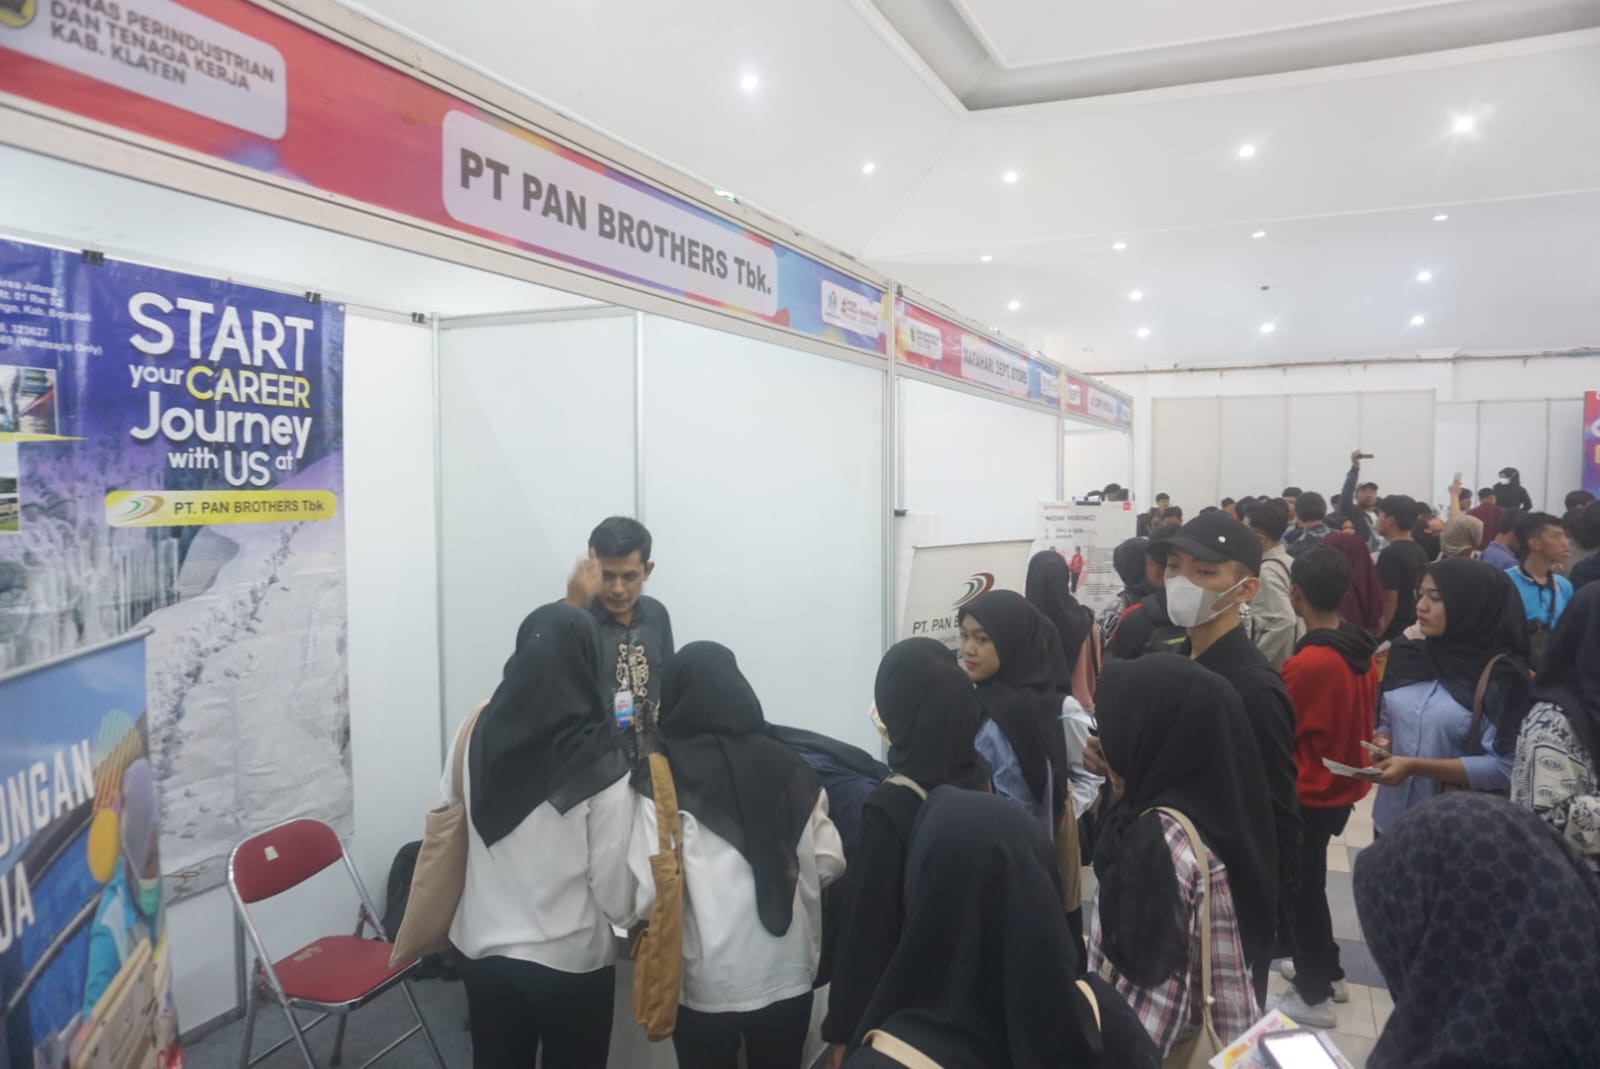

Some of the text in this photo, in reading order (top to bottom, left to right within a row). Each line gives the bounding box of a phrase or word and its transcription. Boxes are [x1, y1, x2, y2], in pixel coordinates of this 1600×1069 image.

[51, 0, 250, 91] DAN TENAGA KERJA
[51, 21, 186, 85] KAB. KLATEN
[126, 10, 274, 83] PERINDUSTRIAN
[460, 147, 772, 295] PT PAN BROTHERS Tbk.
[129, 292, 314, 372] START
[130, 364, 310, 408] your CAREER
[130, 391, 312, 458] Journey
[168, 447, 293, 486] with US at
[174, 499, 324, 515] PT. PAN BROTHERS Tbk
[912, 620, 929, 635] PT.
[931, 617, 952, 632] PAN
